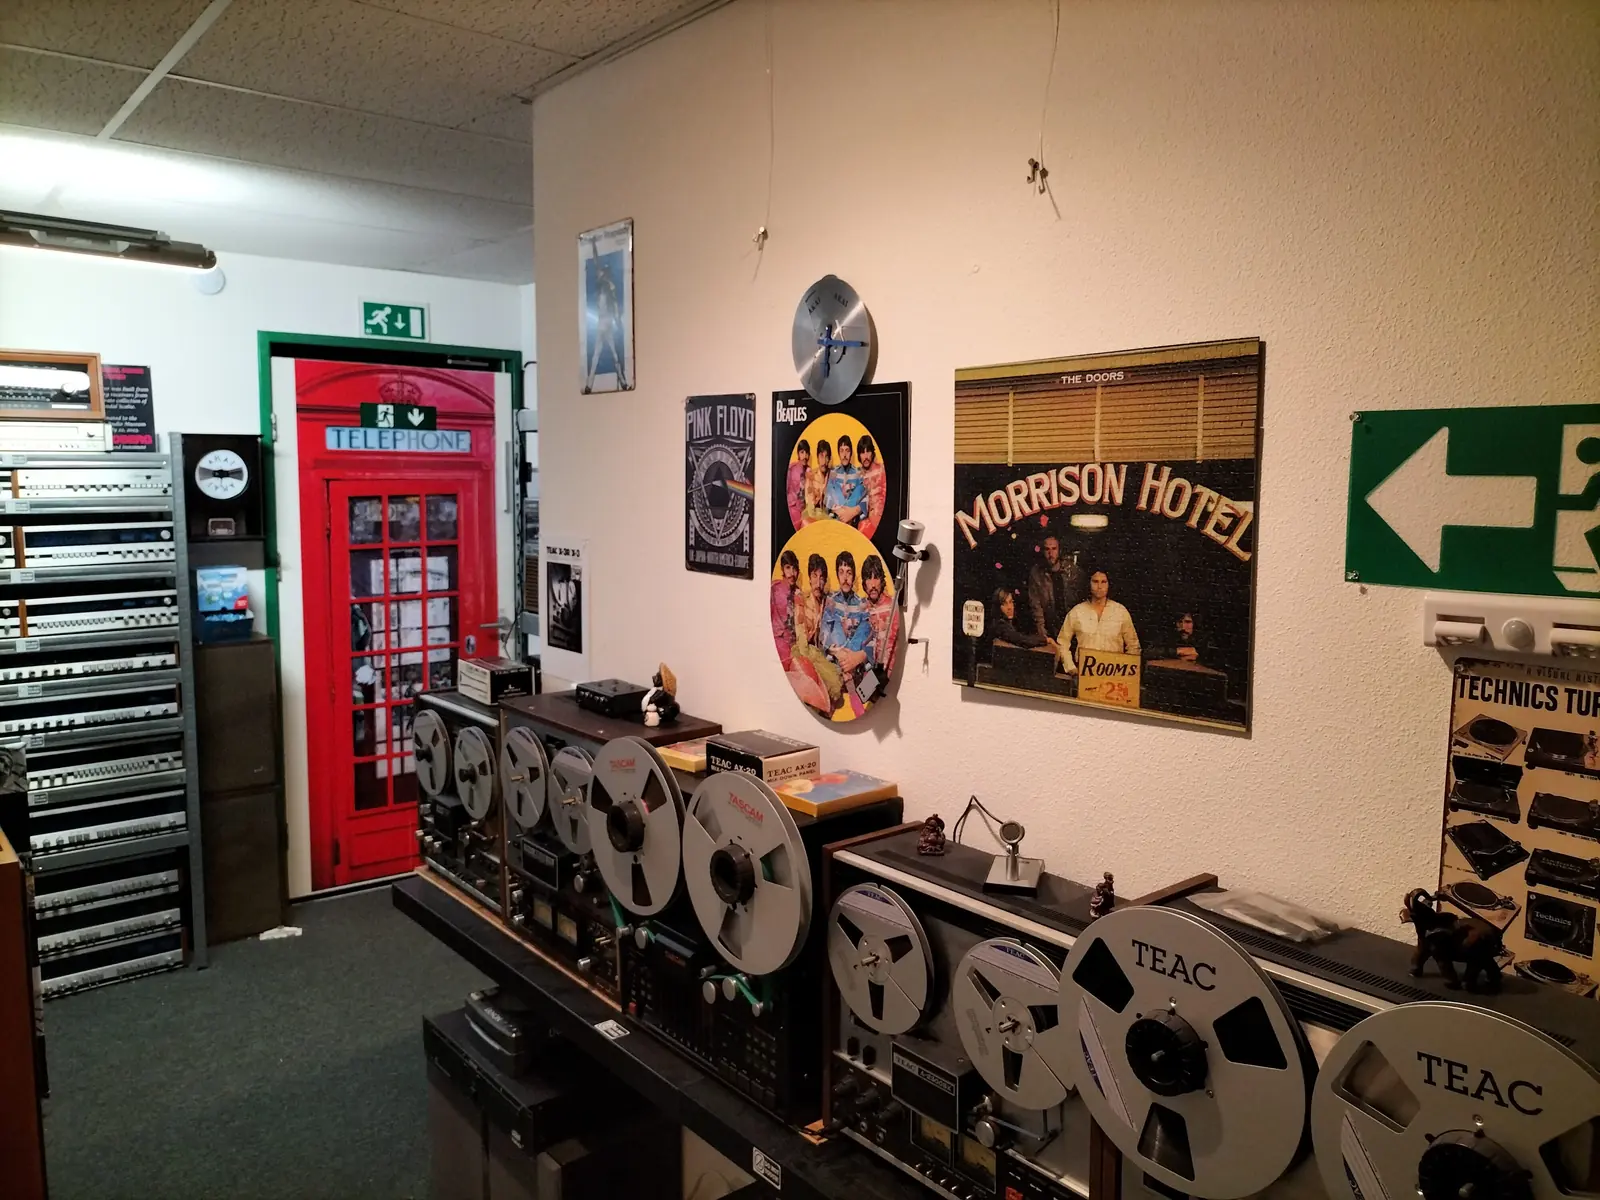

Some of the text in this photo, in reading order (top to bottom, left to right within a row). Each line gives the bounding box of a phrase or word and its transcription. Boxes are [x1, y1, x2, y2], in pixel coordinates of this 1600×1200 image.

[1061, 371, 1124, 384] THE DOORS
[686, 405, 754, 441] PINK FLOYD
[776, 400, 807, 425] BEATLES
[331, 428, 467, 451] TELEPHONE
[954, 462, 1254, 562] MORRISON HOTEL
[1081, 655, 1138, 676] ROOMS
[1457, 674, 1559, 712] TECHNICS
[710, 755, 732, 770] TEAC
[767, 762, 817, 778] TEAC AX-20
[729, 792, 764, 823] TASCAM
[1534, 910, 1572, 927] Technics
[1131, 938, 1217, 991] TEAC
[1416, 1050, 1544, 1116] TEAC
